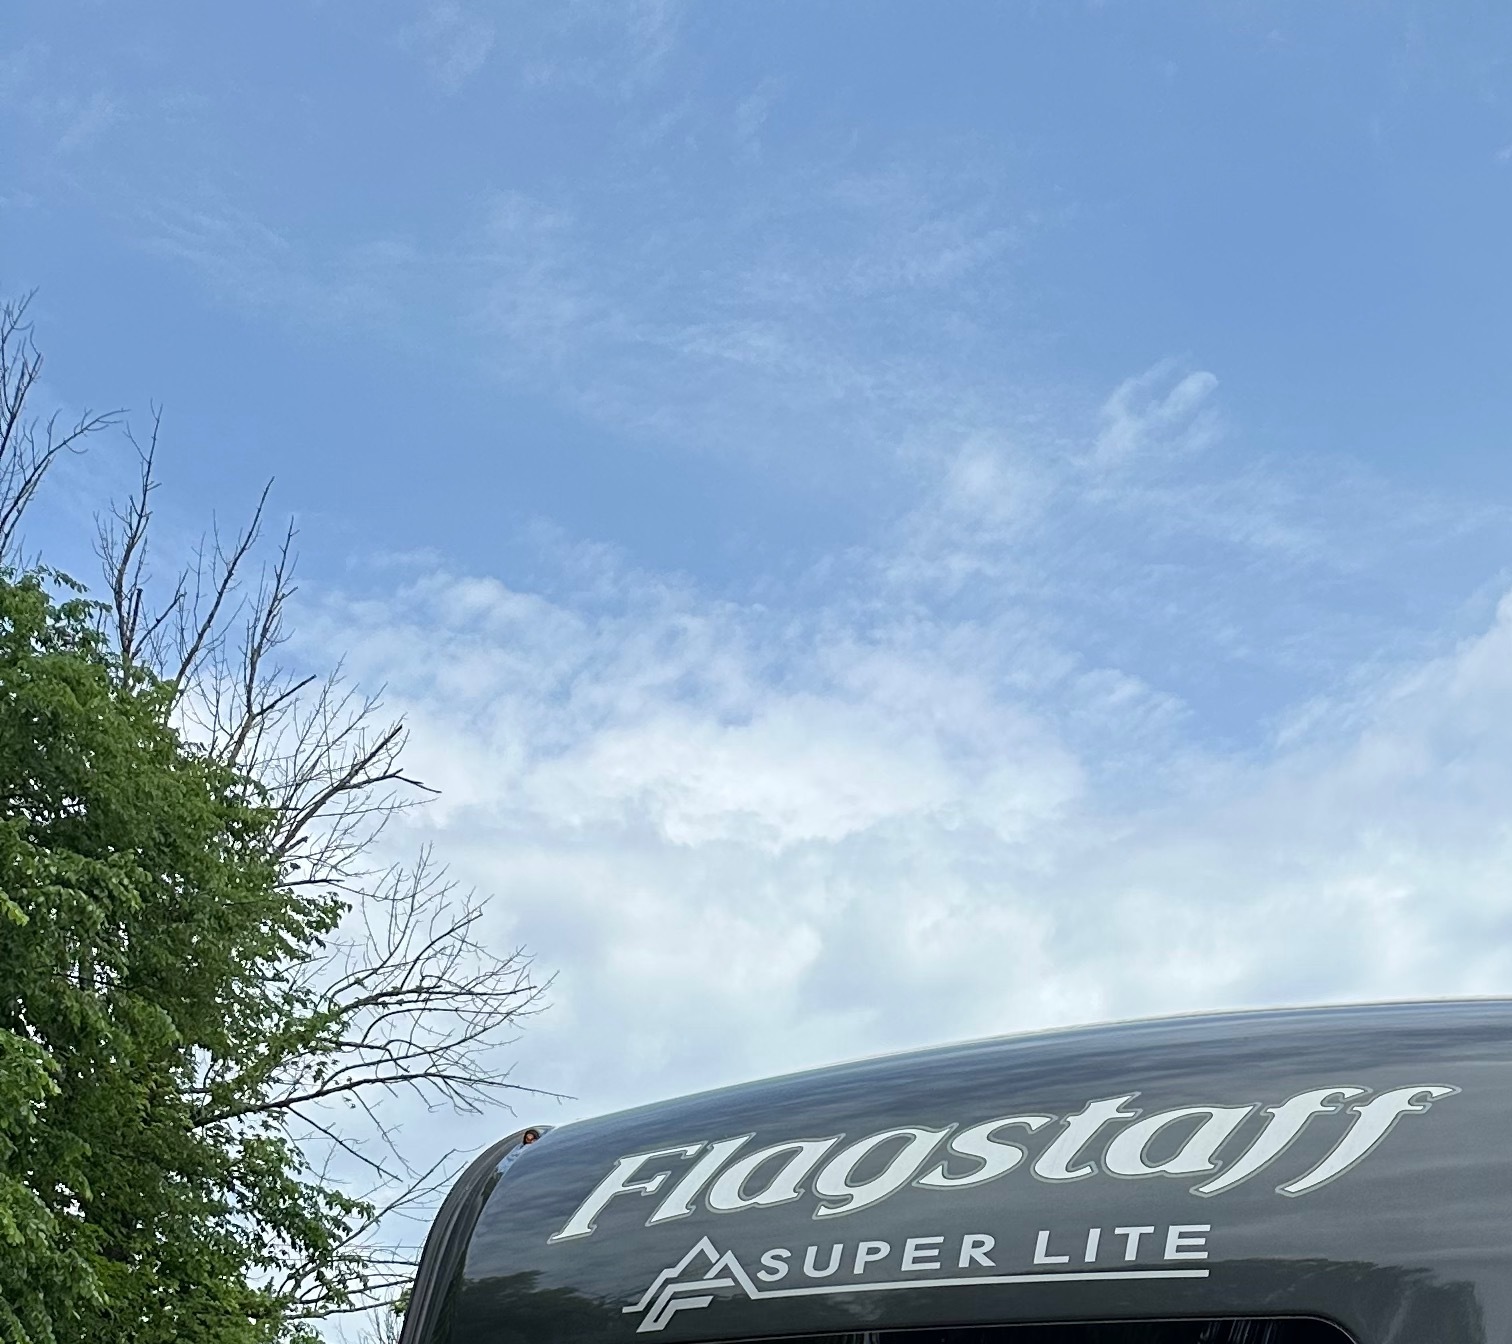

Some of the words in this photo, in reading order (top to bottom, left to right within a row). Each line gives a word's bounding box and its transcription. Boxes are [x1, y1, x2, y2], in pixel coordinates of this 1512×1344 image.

[549, 1084, 1461, 1243] Flagstaff
[756, 1233, 997, 1283] SUPER
[1033, 1224, 1211, 1265] LITE
